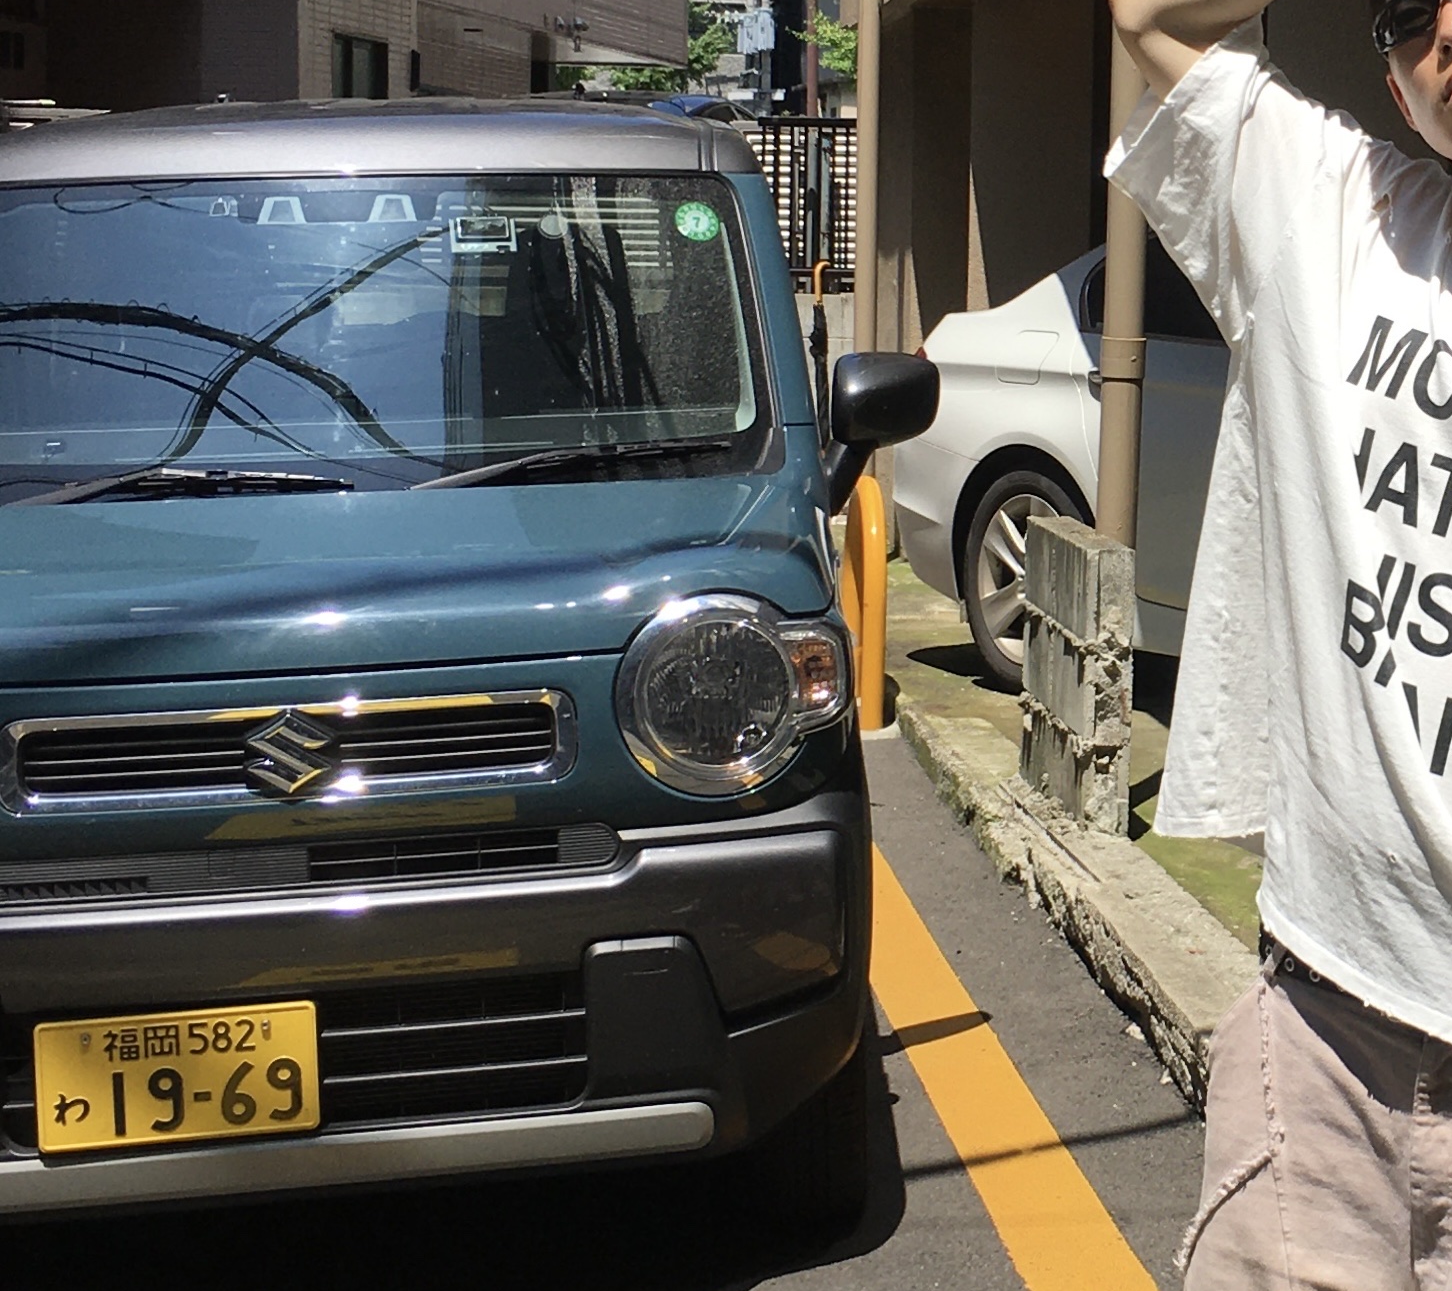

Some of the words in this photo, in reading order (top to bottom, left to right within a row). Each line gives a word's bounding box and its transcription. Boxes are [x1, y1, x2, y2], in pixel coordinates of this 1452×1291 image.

[692, 216, 701, 229] 7
[102, 1023, 182, 1062] 福岡
[188, 1019, 257, 1055] 582
[53, 1093, 91, 1126] わ
[111, 1057, 304, 1138] 19-69
